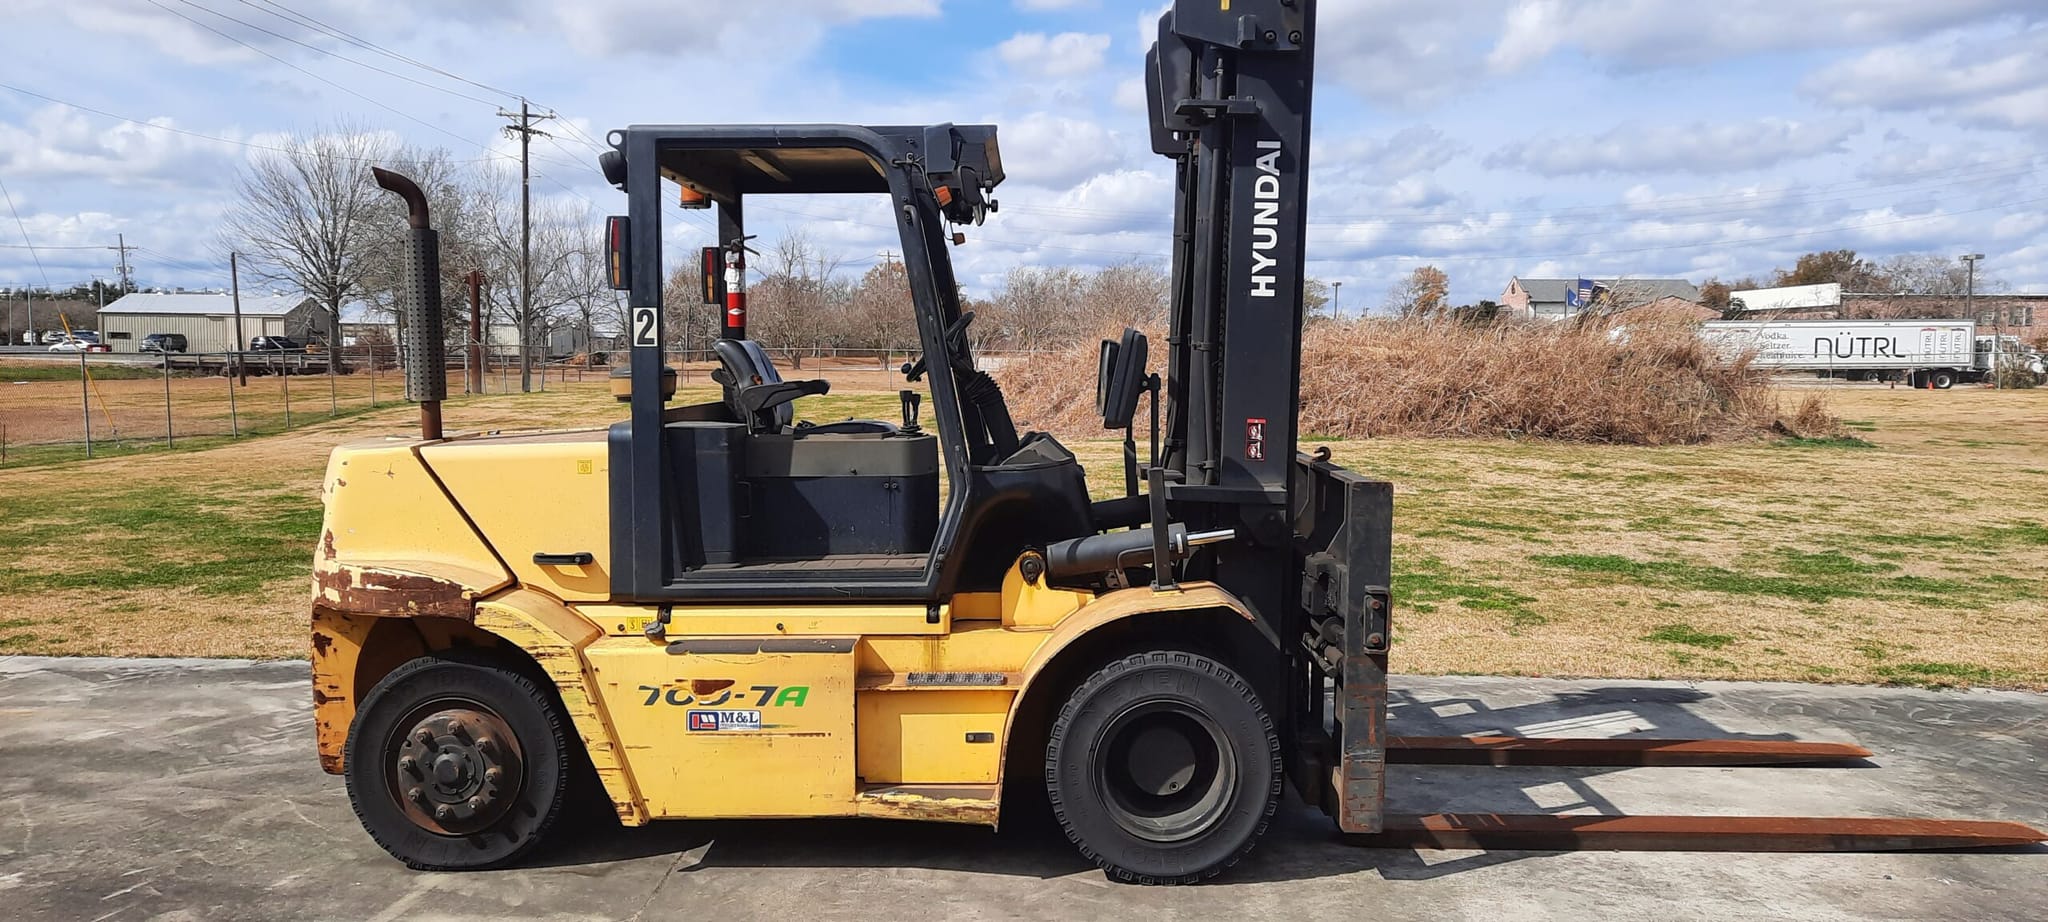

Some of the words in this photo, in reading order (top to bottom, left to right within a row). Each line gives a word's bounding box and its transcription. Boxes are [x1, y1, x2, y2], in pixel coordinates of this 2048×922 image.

[1251, 141, 1281, 297] HYUNDAI
[637, 309, 654, 344] 2
[1814, 332, 1906, 358] NÜTRL
[720, 712, 759, 723] M&L
